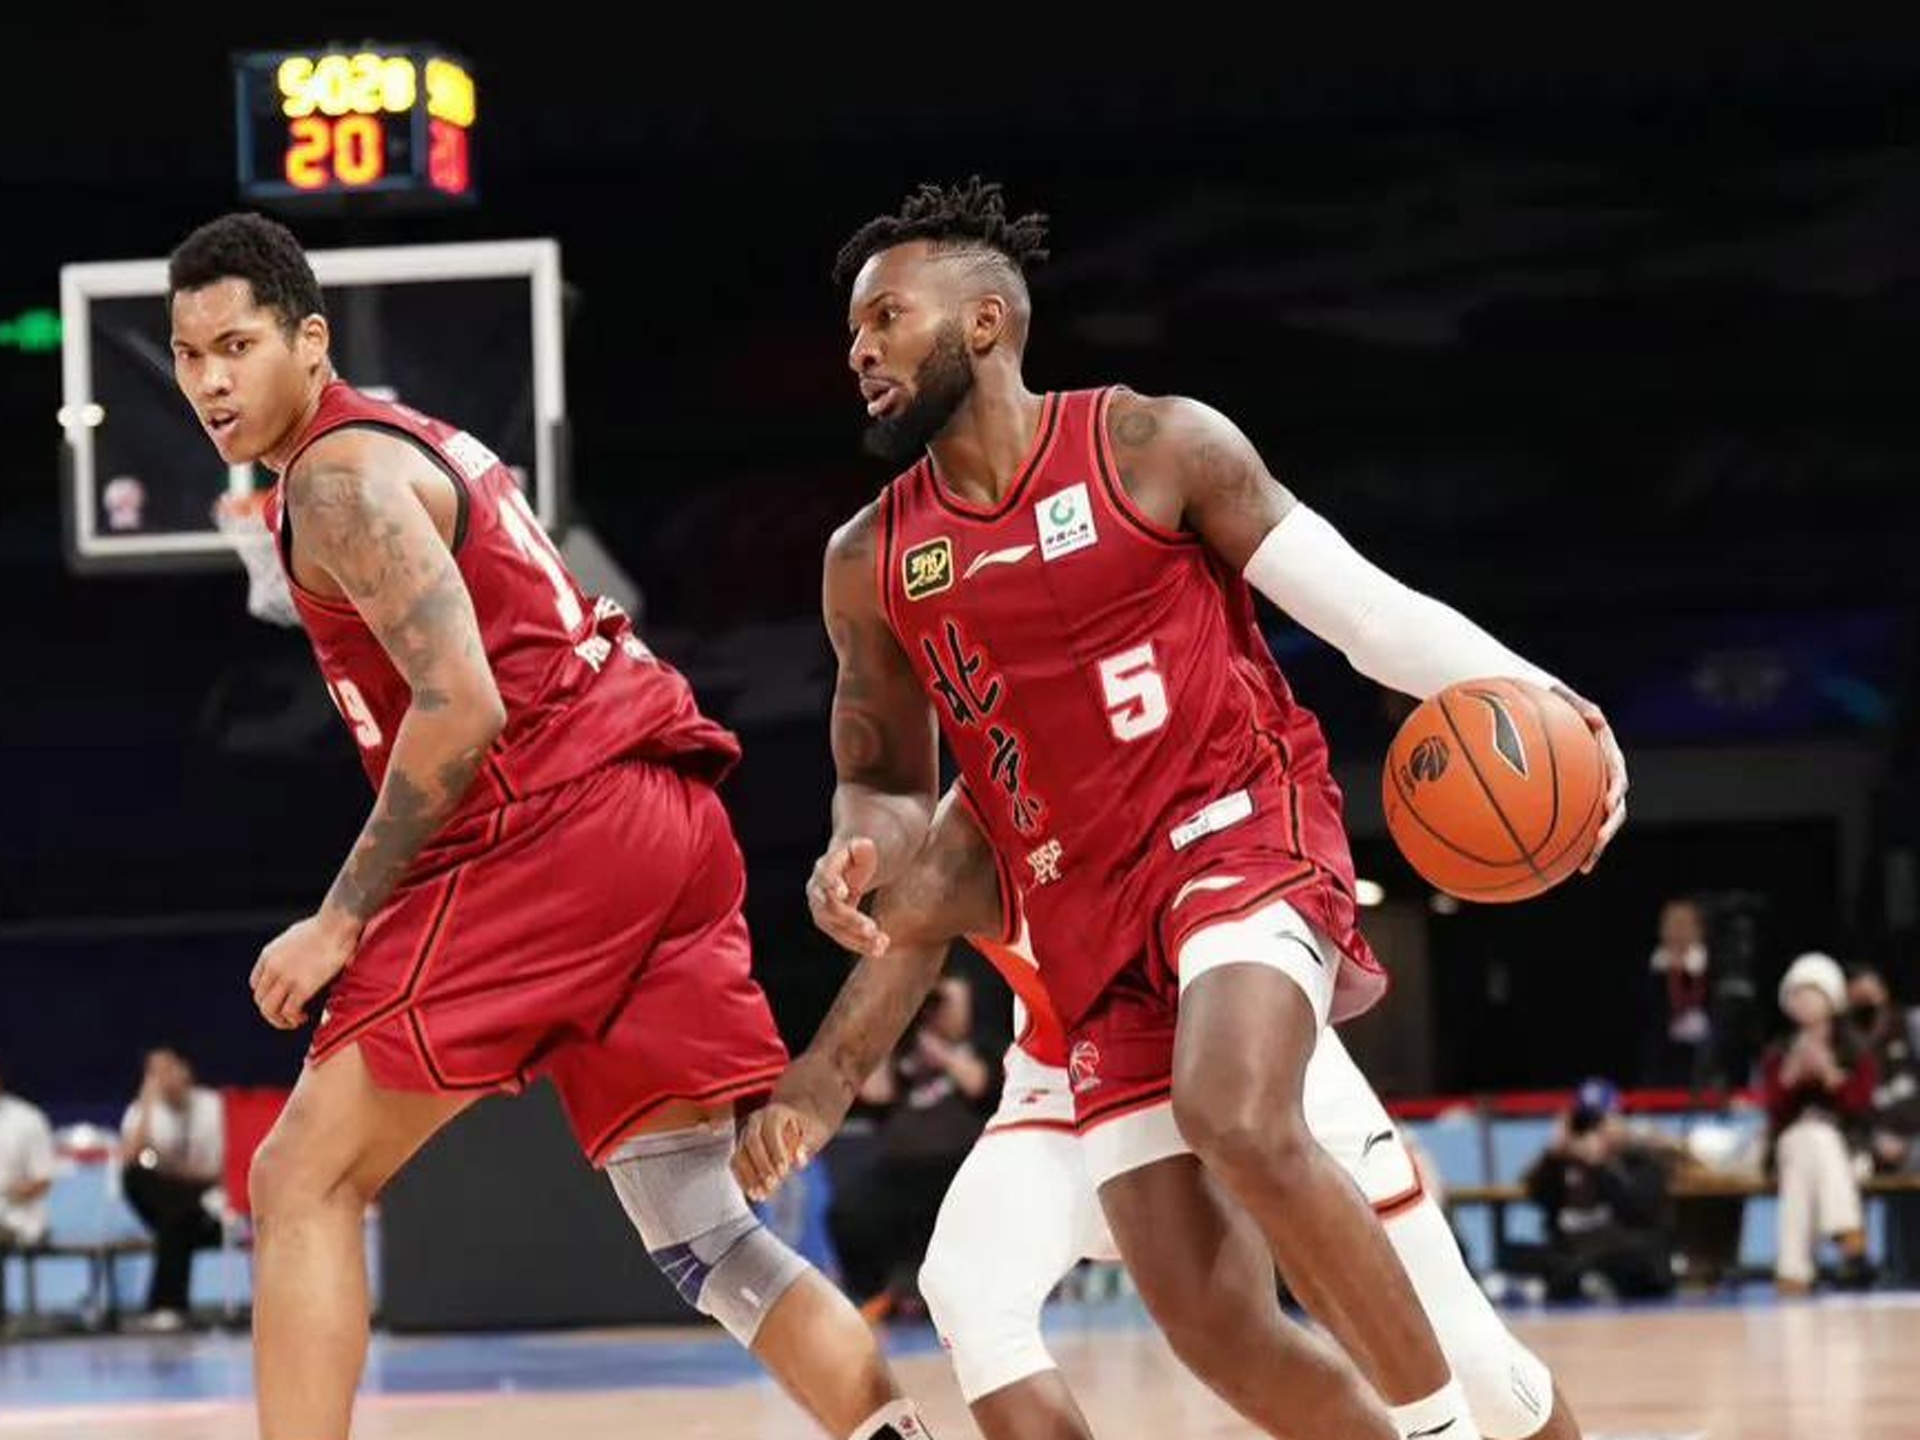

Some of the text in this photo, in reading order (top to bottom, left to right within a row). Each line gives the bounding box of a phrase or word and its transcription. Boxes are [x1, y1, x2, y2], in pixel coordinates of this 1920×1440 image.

[286, 116, 384, 191] 20
[499, 488, 585, 634] 1
[326, 679, 383, 748] 9
[923, 619, 1042, 832] 北京
[1099, 641, 1168, 742] 5
